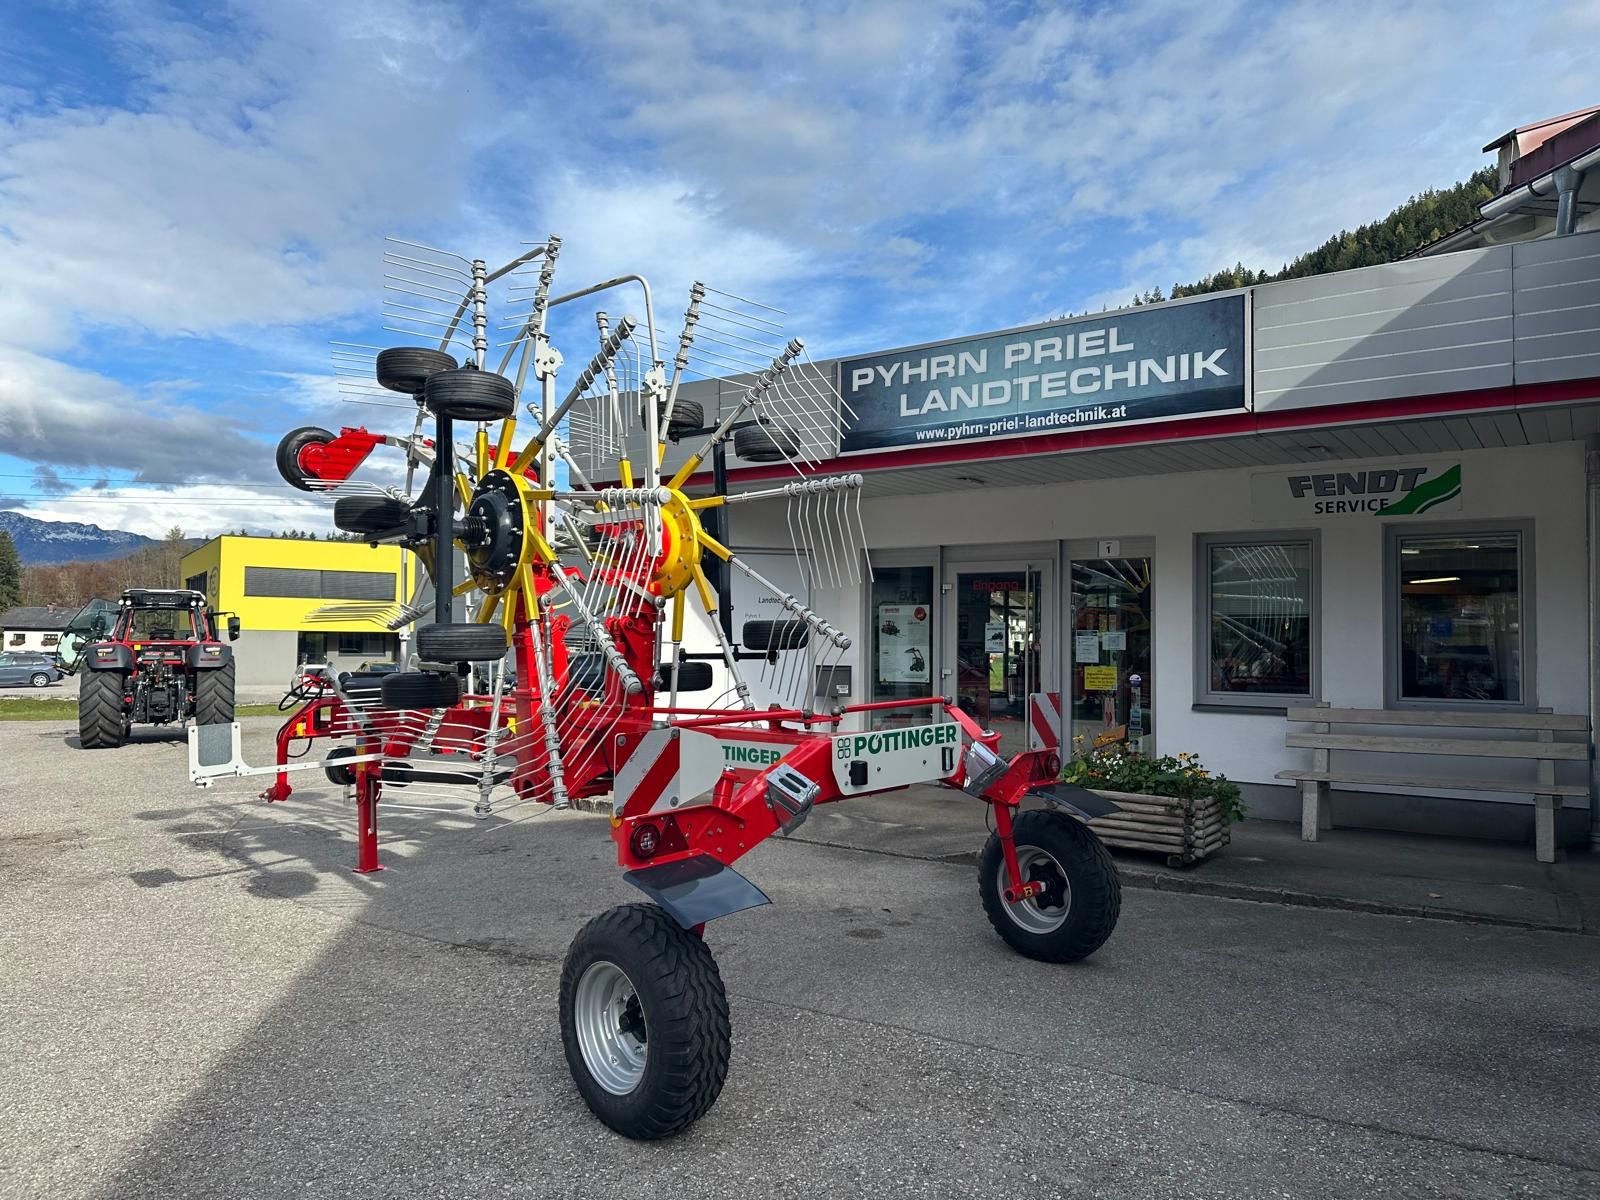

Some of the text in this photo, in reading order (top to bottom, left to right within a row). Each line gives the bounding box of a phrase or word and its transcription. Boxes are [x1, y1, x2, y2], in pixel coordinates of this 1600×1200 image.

[852, 327, 1134, 392] PYHRN PRIEL
[899, 348, 1229, 417] LANDTECHNIK
[916, 404, 1127, 441] www.pyhrn-priel-landtechnik.at
[1287, 467, 1427, 498] FENDT
[1314, 498, 1389, 514] SERVICE
